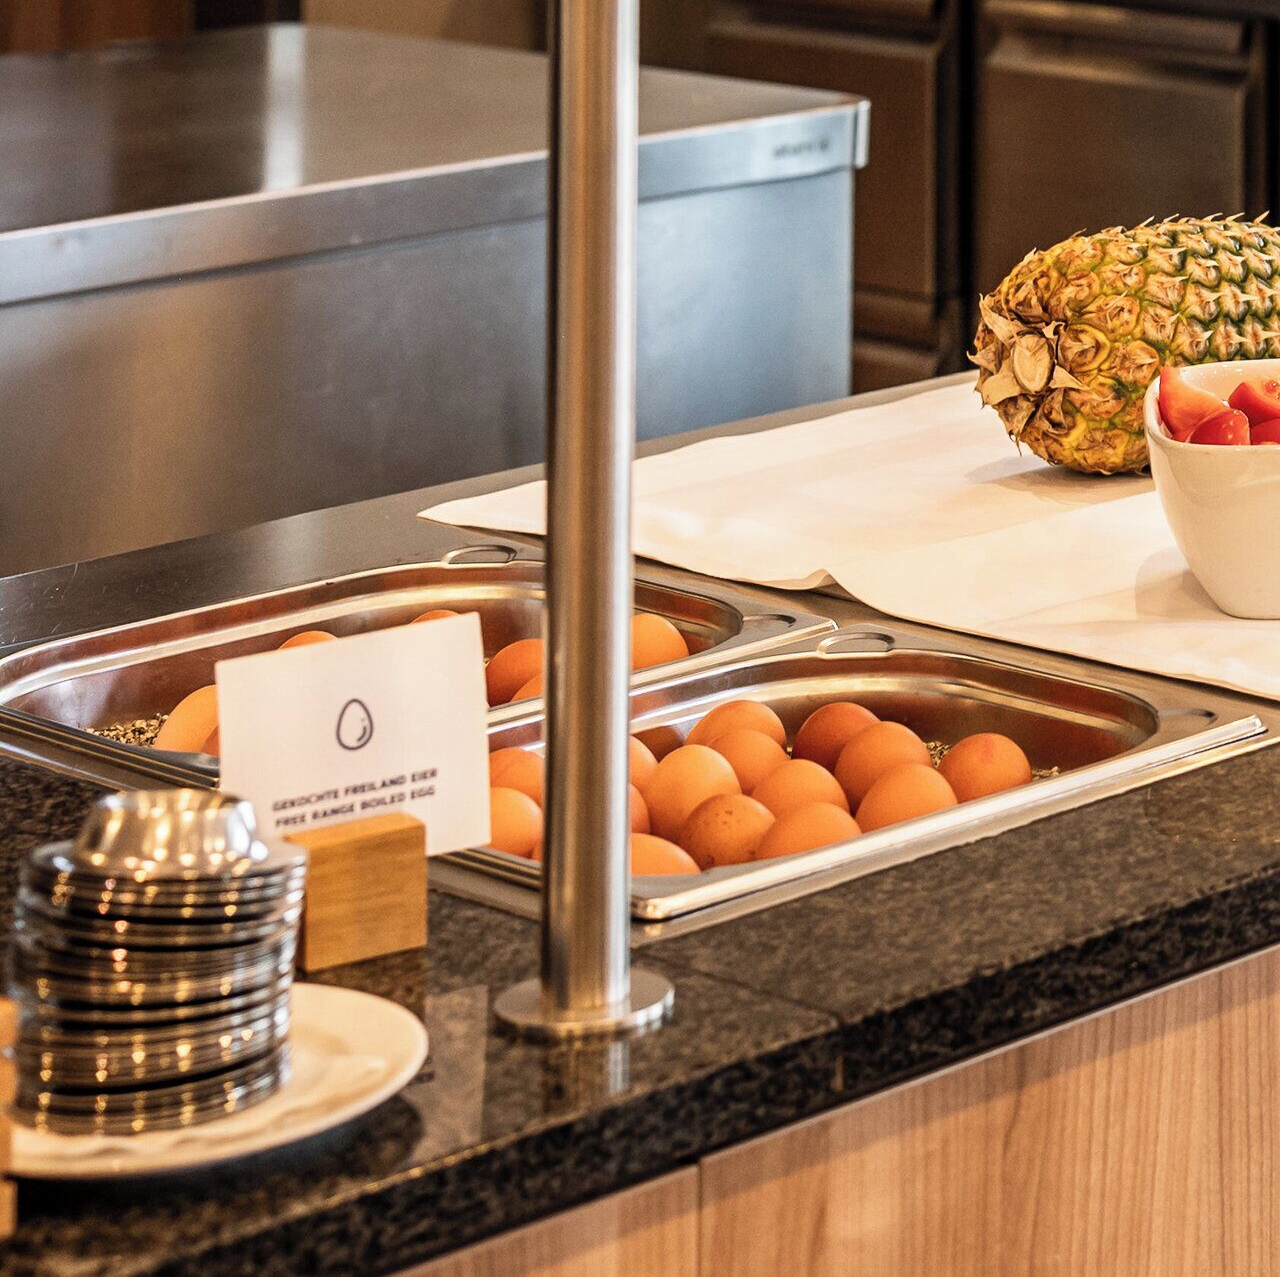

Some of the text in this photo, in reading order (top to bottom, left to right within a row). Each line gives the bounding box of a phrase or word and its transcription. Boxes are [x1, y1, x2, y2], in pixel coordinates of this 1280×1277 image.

[272, 767, 437, 811] GEKOCHTE FREILAND EIER
[275, 785, 435, 827] FREE RANGE BOILED EGG
